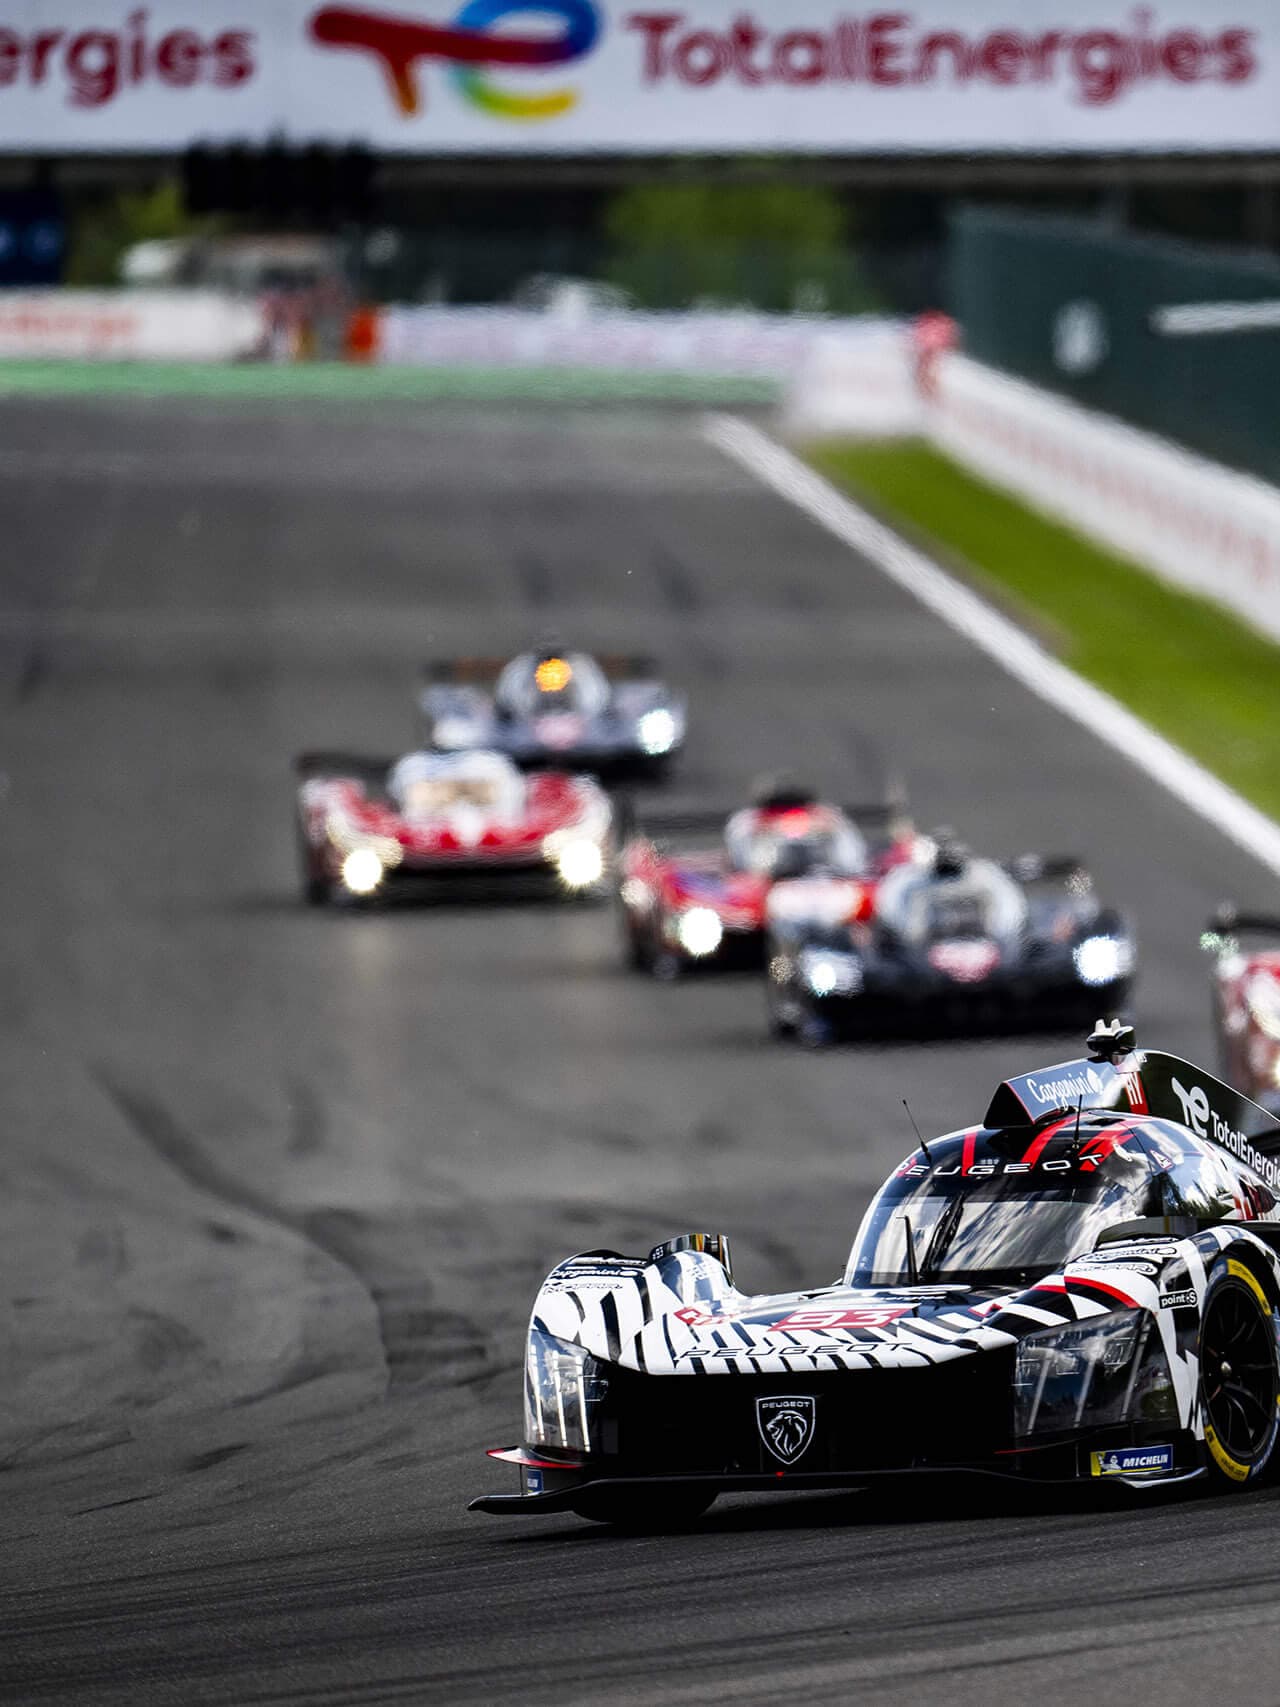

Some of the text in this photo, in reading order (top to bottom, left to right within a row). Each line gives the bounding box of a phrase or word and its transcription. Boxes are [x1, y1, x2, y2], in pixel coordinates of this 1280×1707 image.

[625, 4, 1255, 107] TotalEnergies
[1027, 1069, 1091, 1112] Capgemini
[898, 1153, 1103, 1176] PEUGEOT
[778, 1308, 891, 1326] 93
[679, 1342, 912, 1359] PEUGEOT
[762, 1401, 810, 1409] PEUGEOT
[1123, 1453, 1169, 1468] MICHELIN
